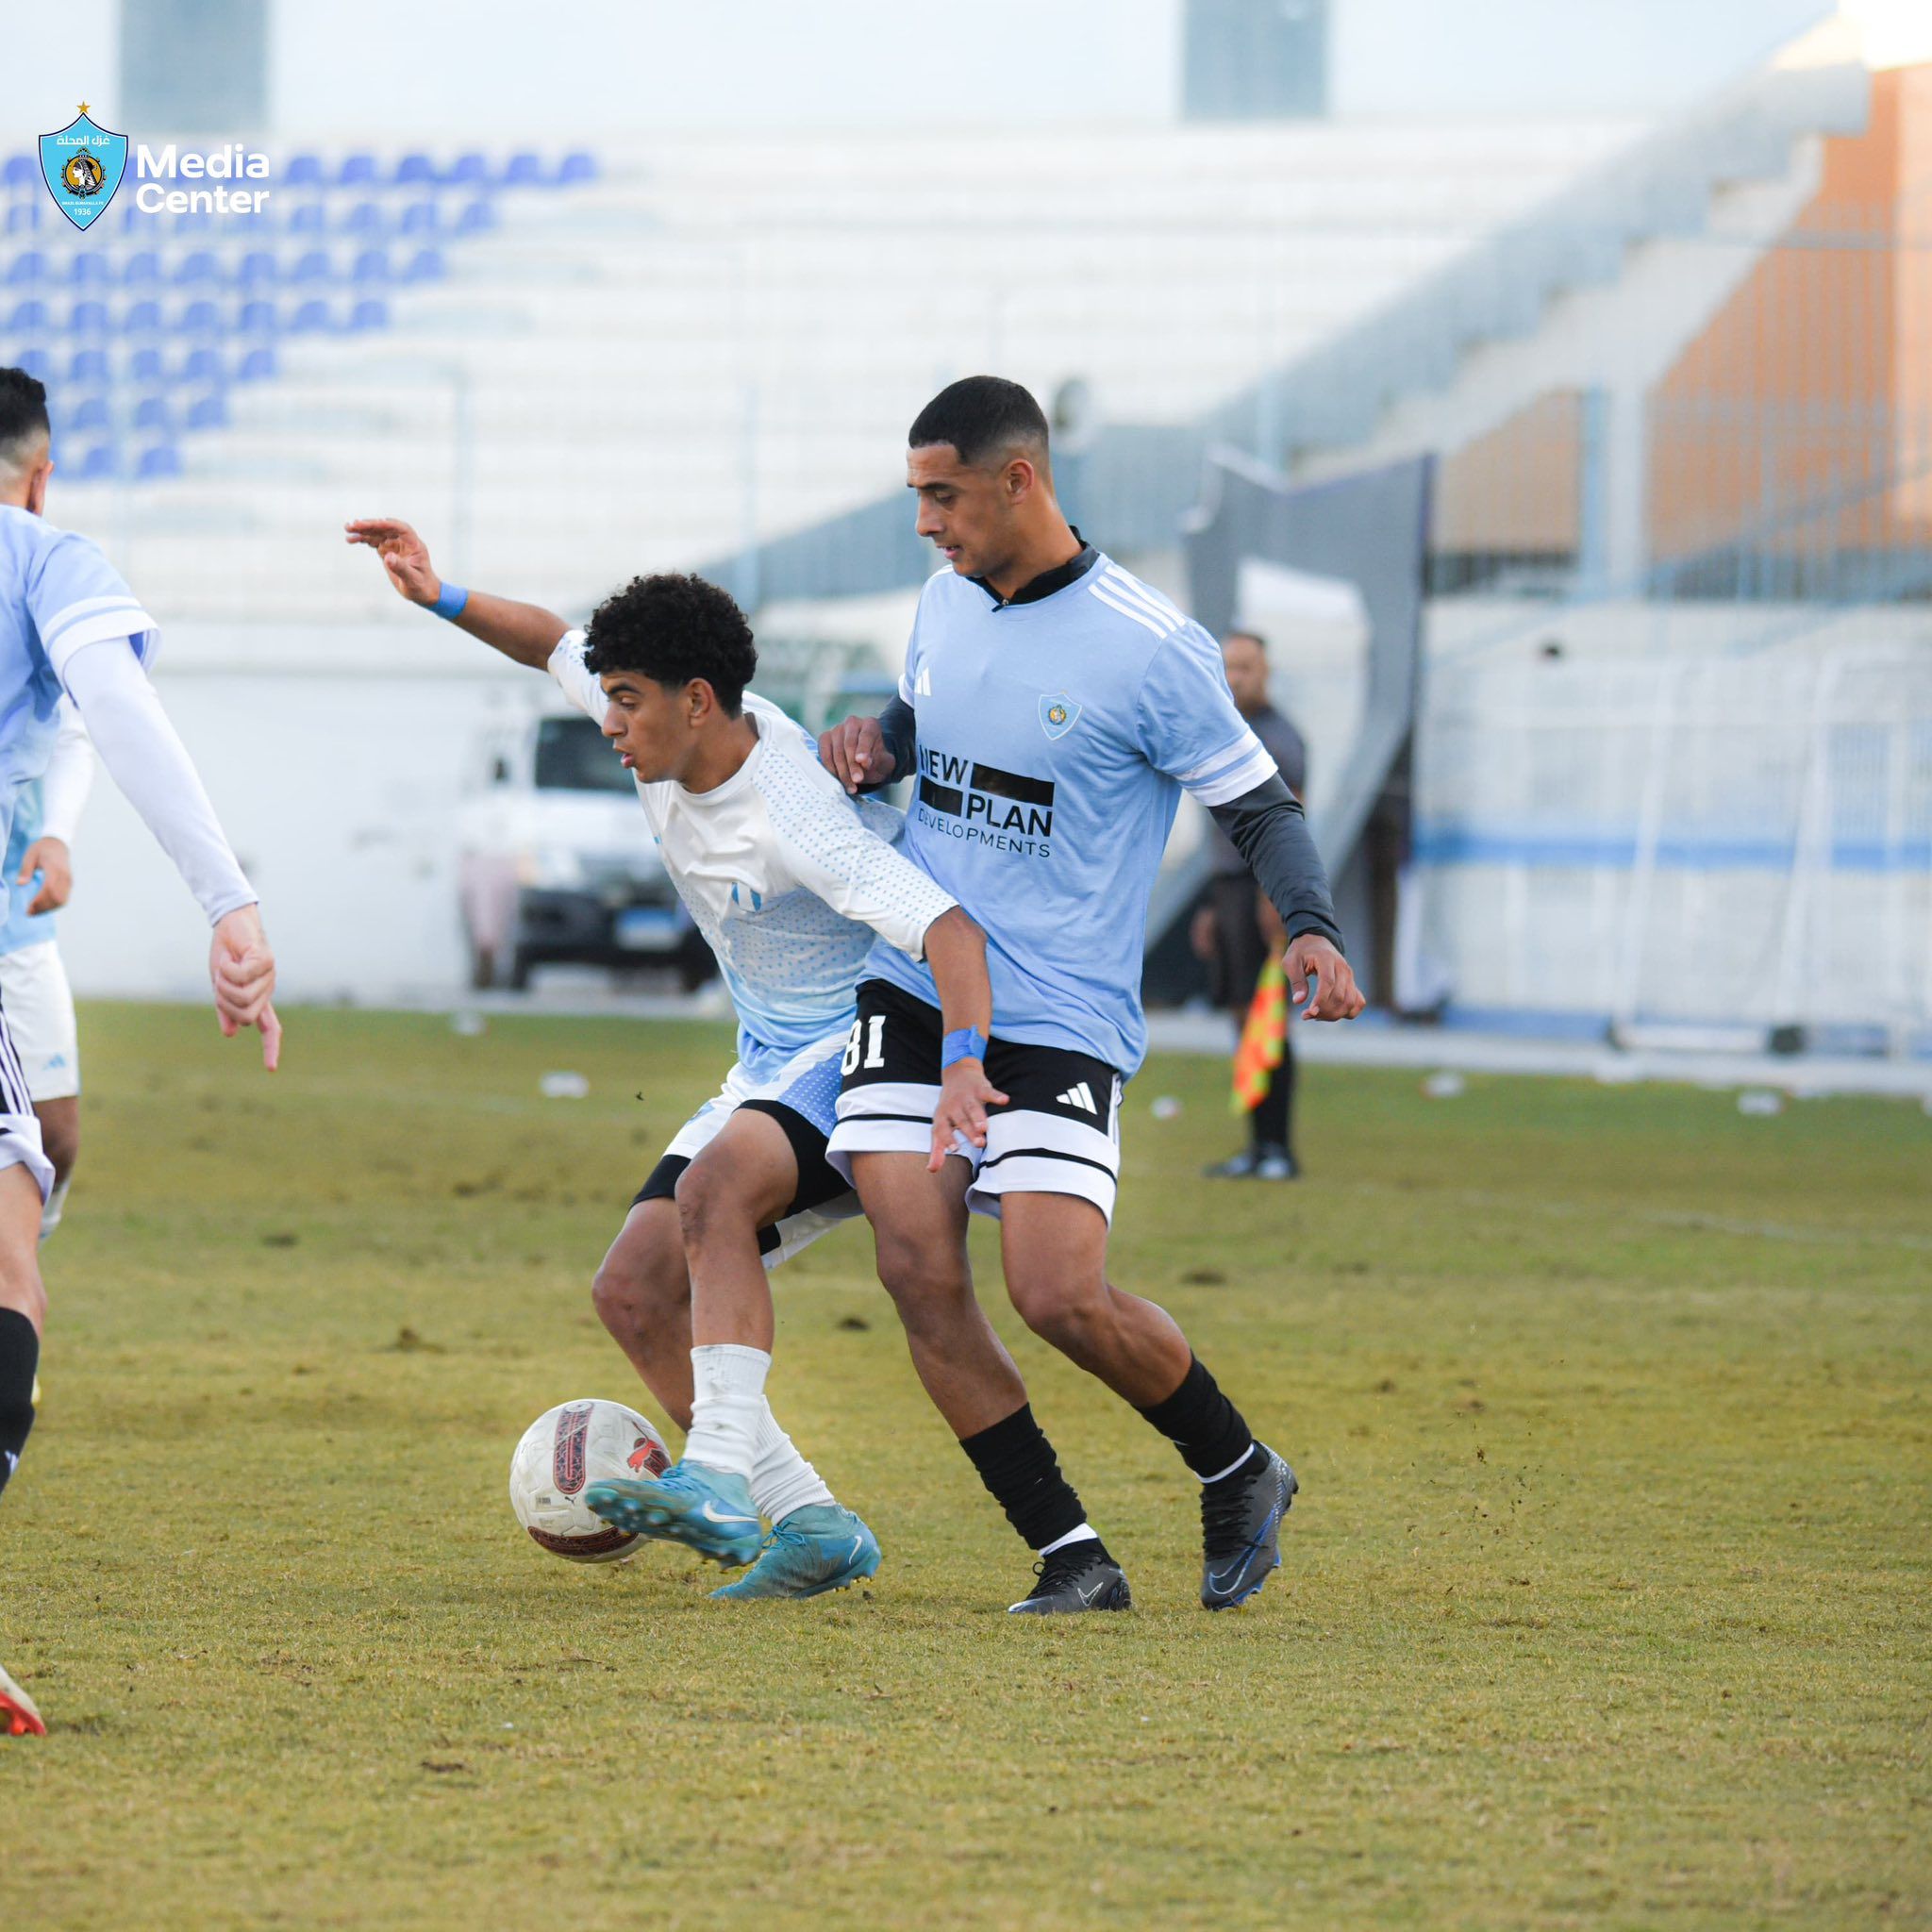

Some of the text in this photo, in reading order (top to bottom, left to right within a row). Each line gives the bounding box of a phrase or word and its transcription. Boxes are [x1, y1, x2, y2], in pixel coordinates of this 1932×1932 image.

[919, 744, 969, 785] NEW
[918, 808, 1050, 858] DEVELOPMENTS
[966, 793, 1053, 838] PLAN
[841, 1015, 886, 1076] 81
